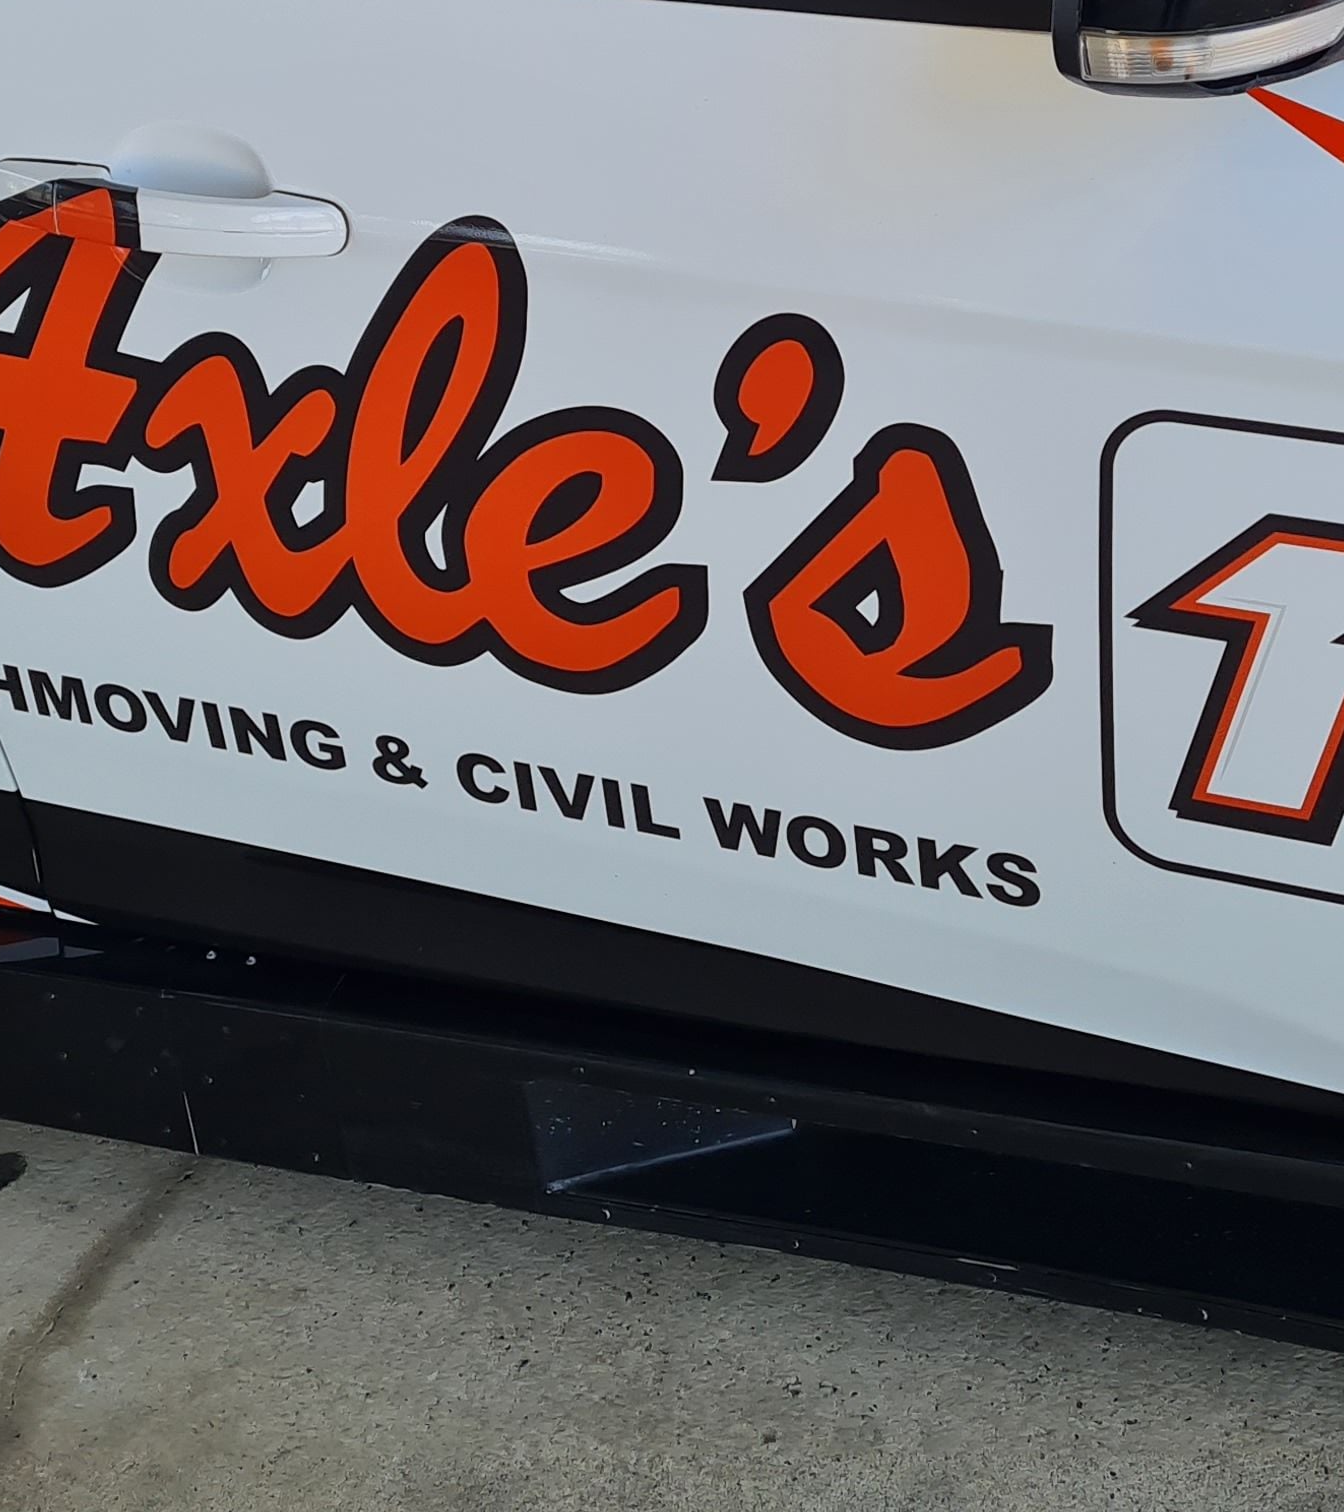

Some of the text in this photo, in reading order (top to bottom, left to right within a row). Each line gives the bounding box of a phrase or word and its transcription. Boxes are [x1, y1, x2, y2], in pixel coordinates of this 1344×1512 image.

[372, 733, 429, 790] &
[455, 752, 681, 840] CIVIL
[703, 796, 1043, 908] WORKS
